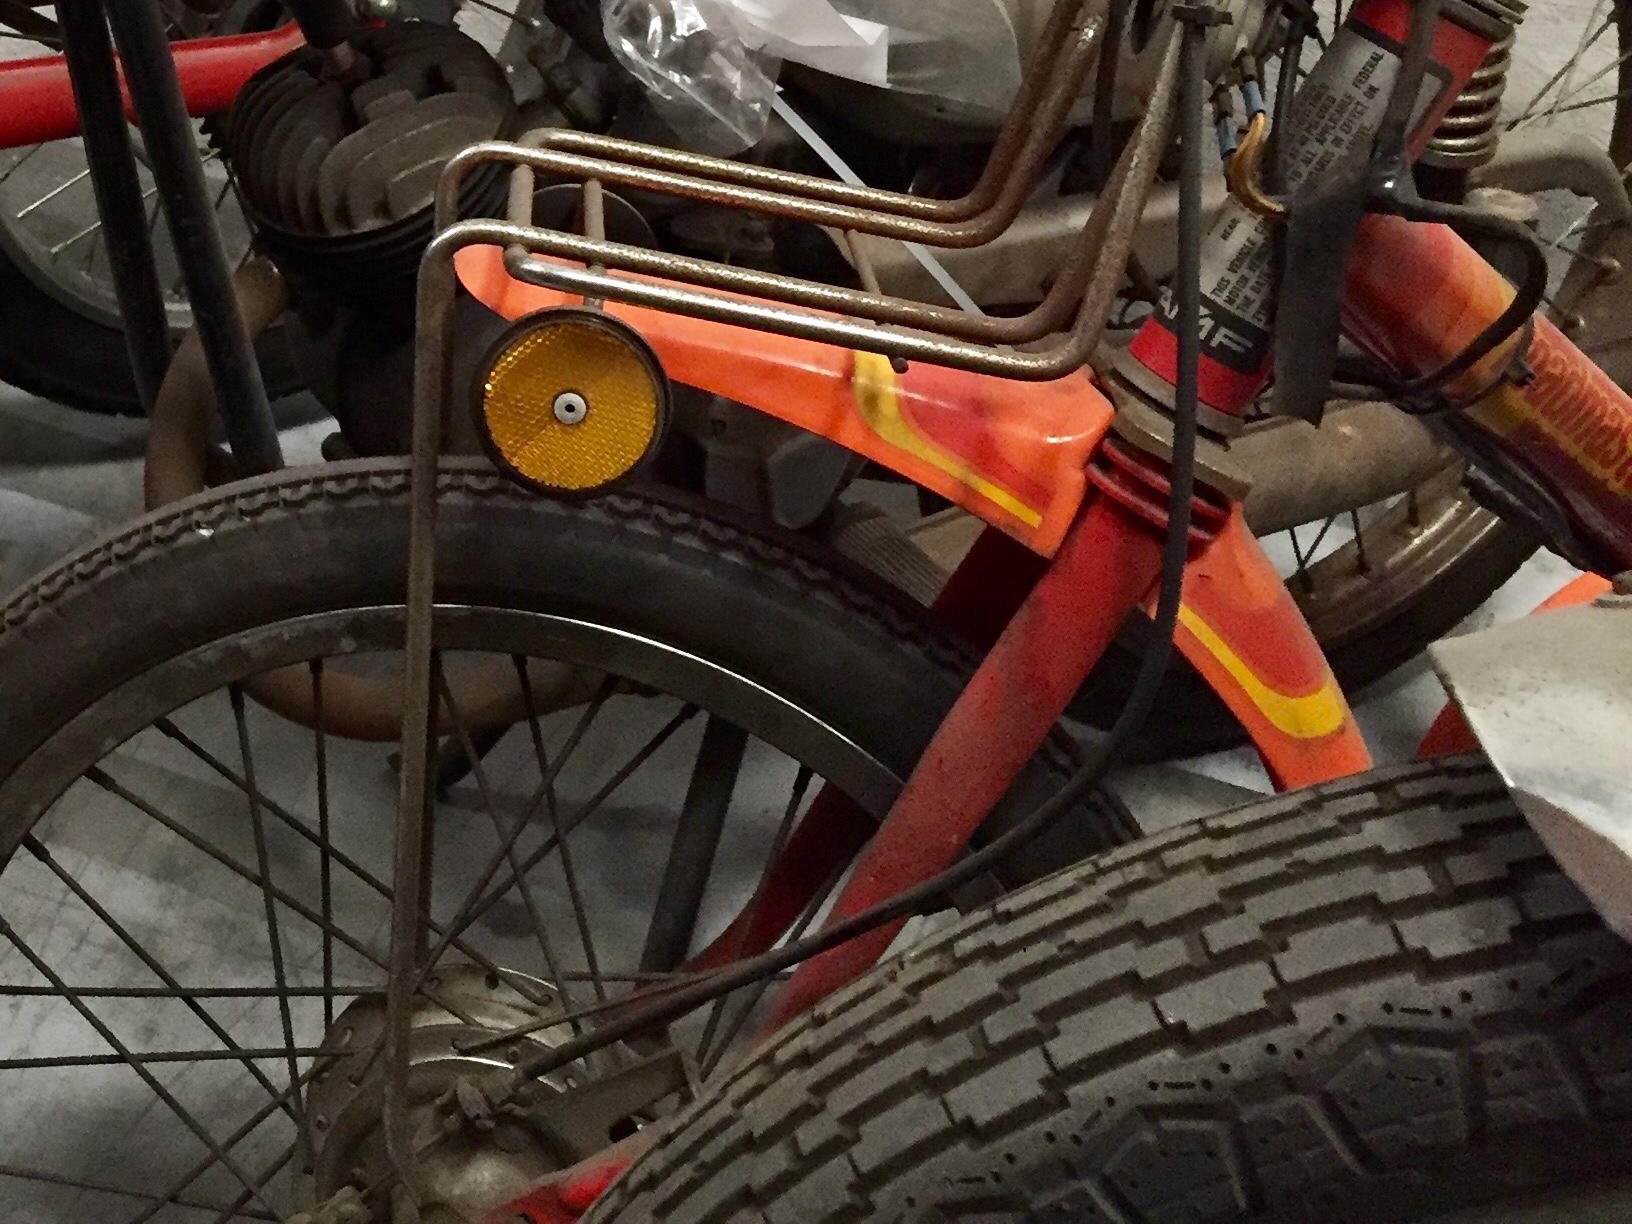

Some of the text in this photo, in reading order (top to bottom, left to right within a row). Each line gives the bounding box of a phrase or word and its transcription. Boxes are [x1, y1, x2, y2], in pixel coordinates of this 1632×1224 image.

[1350, 48, 1384, 91] FEDERAL
[1210, 235, 1256, 298] THIS VEHICLE
